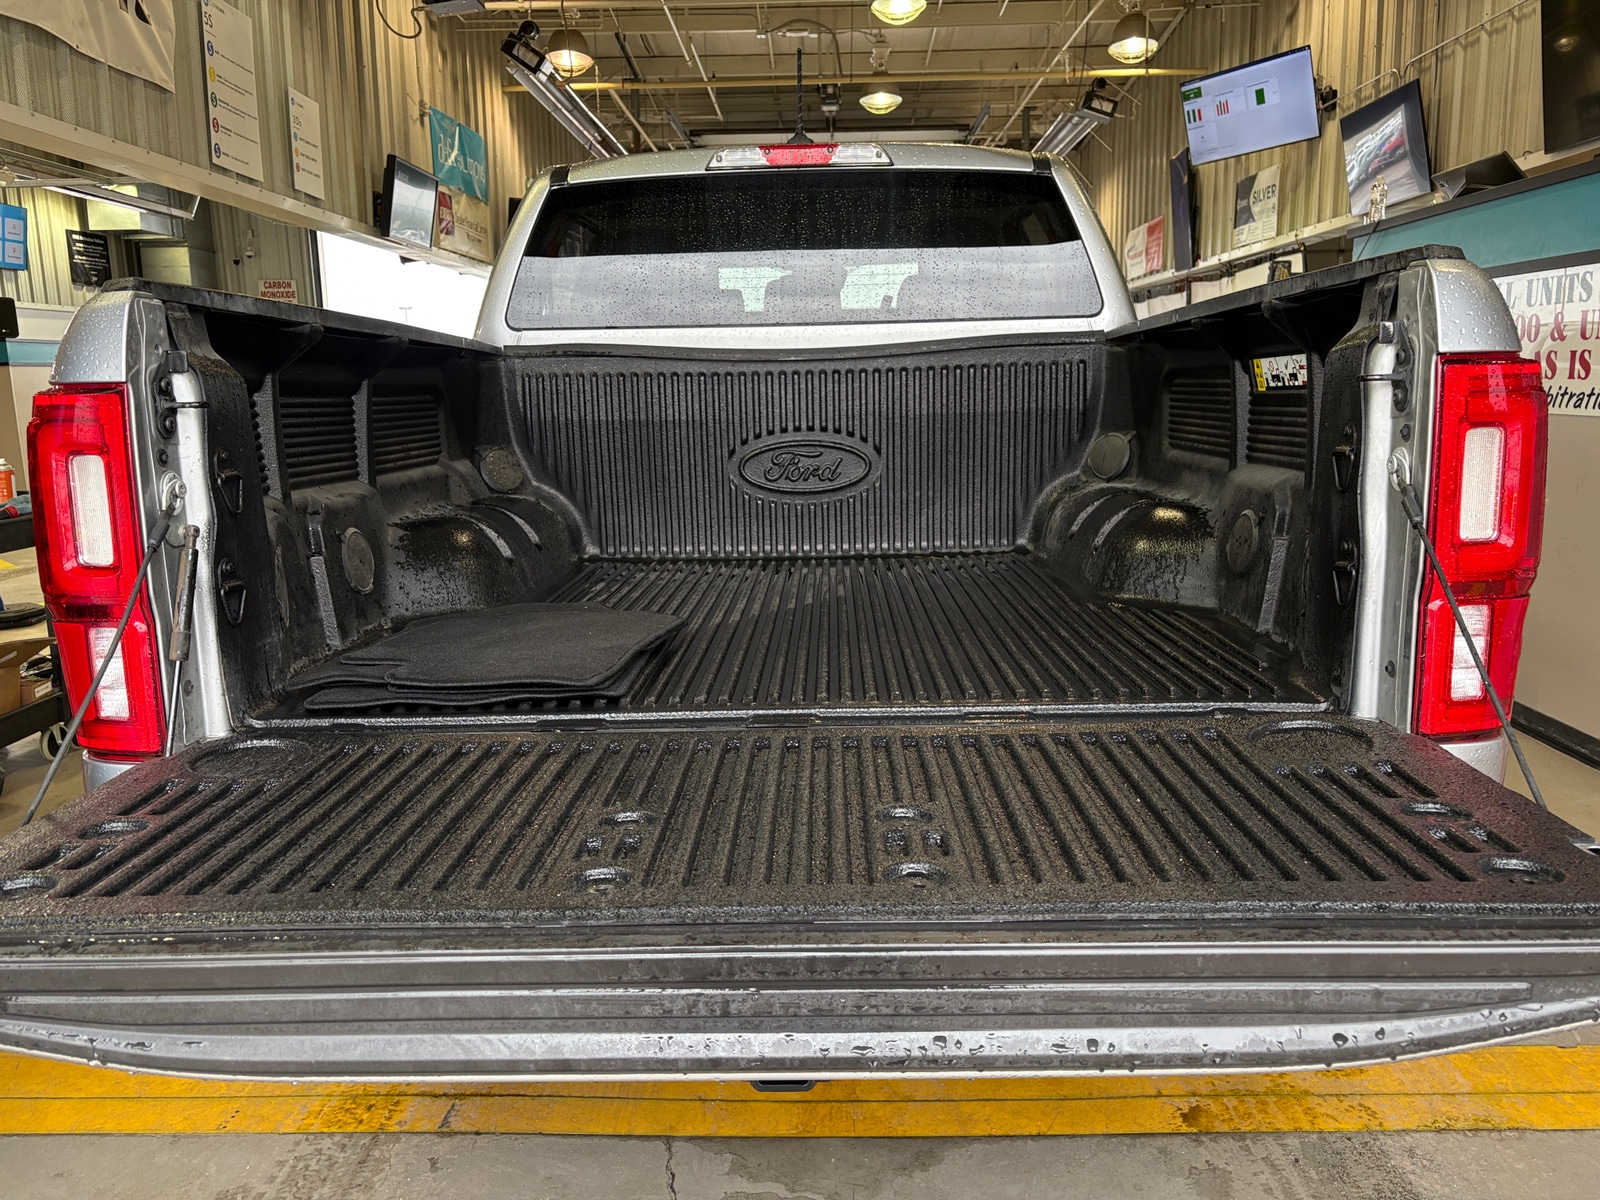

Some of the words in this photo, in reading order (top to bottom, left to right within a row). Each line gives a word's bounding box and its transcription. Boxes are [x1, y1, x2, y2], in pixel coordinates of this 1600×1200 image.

[204, 11, 213, 28] 5S
[1252, 183, 1276, 204] SILVER
[261, 291, 296, 299] MONOXIDE
[263, 281, 291, 289] CARBON
[1526, 271, 1593, 308] UNITS
[1515, 313, 1541, 343] 00
[1550, 312, 1568, 342] &
[1580, 309, 1600, 340] U
[1567, 349, 1592, 380] IS
[1546, 385, 1600, 410] bitrati
[764, 451, 842, 482] Ford
